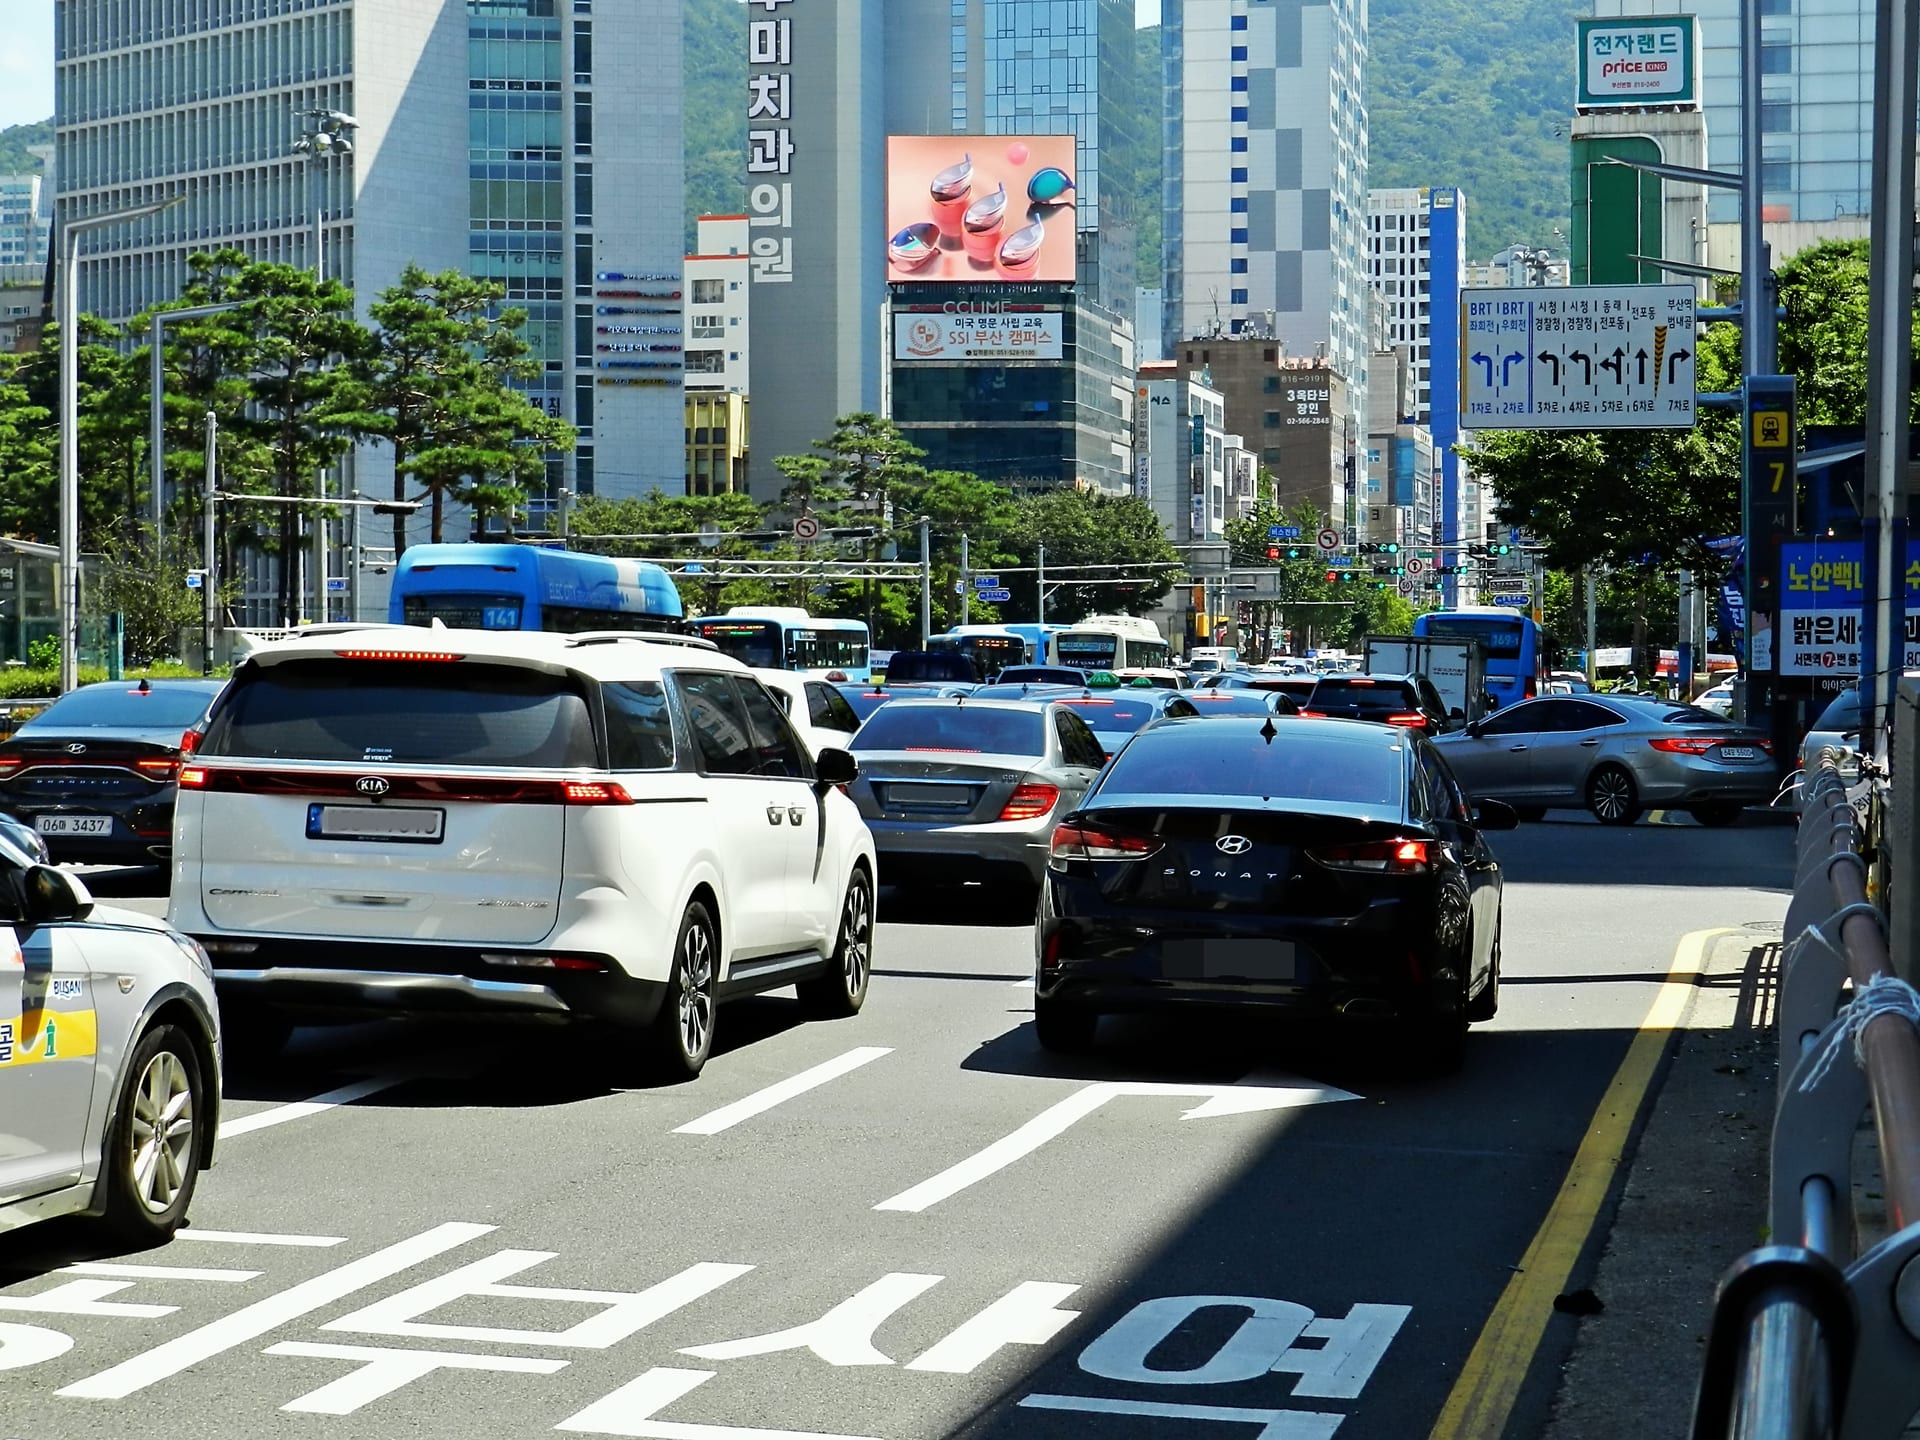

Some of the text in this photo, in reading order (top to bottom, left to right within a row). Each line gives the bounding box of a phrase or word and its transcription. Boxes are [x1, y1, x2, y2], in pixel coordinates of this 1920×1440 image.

[1593, 33, 1678, 55] 전자랜드
[1645, 62, 1668, 72] KING
[1470, 302, 1492, 316] BRT
[1502, 301, 1525, 315] BRT
[1538, 300, 1557, 313] 시청
[1570, 300, 1589, 313] 시청
[1603, 299, 1622, 311] 동래
[1667, 298, 1692, 311] 부산역
[1631, 306, 1656, 321] 전포동
[955, 318, 1043, 328] 미국 명문 사립 교육
[1469, 319, 1494, 332] 좌회전
[1502, 319, 1526, 332] 우회전
[1535, 318, 1561, 332] 경찰청
[1567, 317, 1592, 331] 경찰청
[1600, 316, 1625, 330] 전포동
[1667, 316, 1693, 329] 범내골
[949, 331, 1052, 345] SSI 부산 캠퍼스
[1297, 403, 1319, 415] 장인
[1471, 402, 1492, 414] 1차로
[1503, 402, 1525, 414] 2차로
[1537, 401, 1559, 413] 3차로
[1569, 401, 1591, 413] 4차로
[1601, 401, 1623, 412] 5차로
[1632, 400, 1655, 412] 6차로
[1668, 400, 1690, 411] 7차로
[1769, 463, 1784, 492] 7
[1788, 562, 1863, 591] 노안백
[487, 610, 516, 626] 141
[1793, 616, 1862, 645] 밝은세
[361, 780, 384, 791] KIA
[72, 820, 104, 831] 3437
[1163, 868, 1302, 881] SONATA
[53, 981, 81, 995] BUSAN
